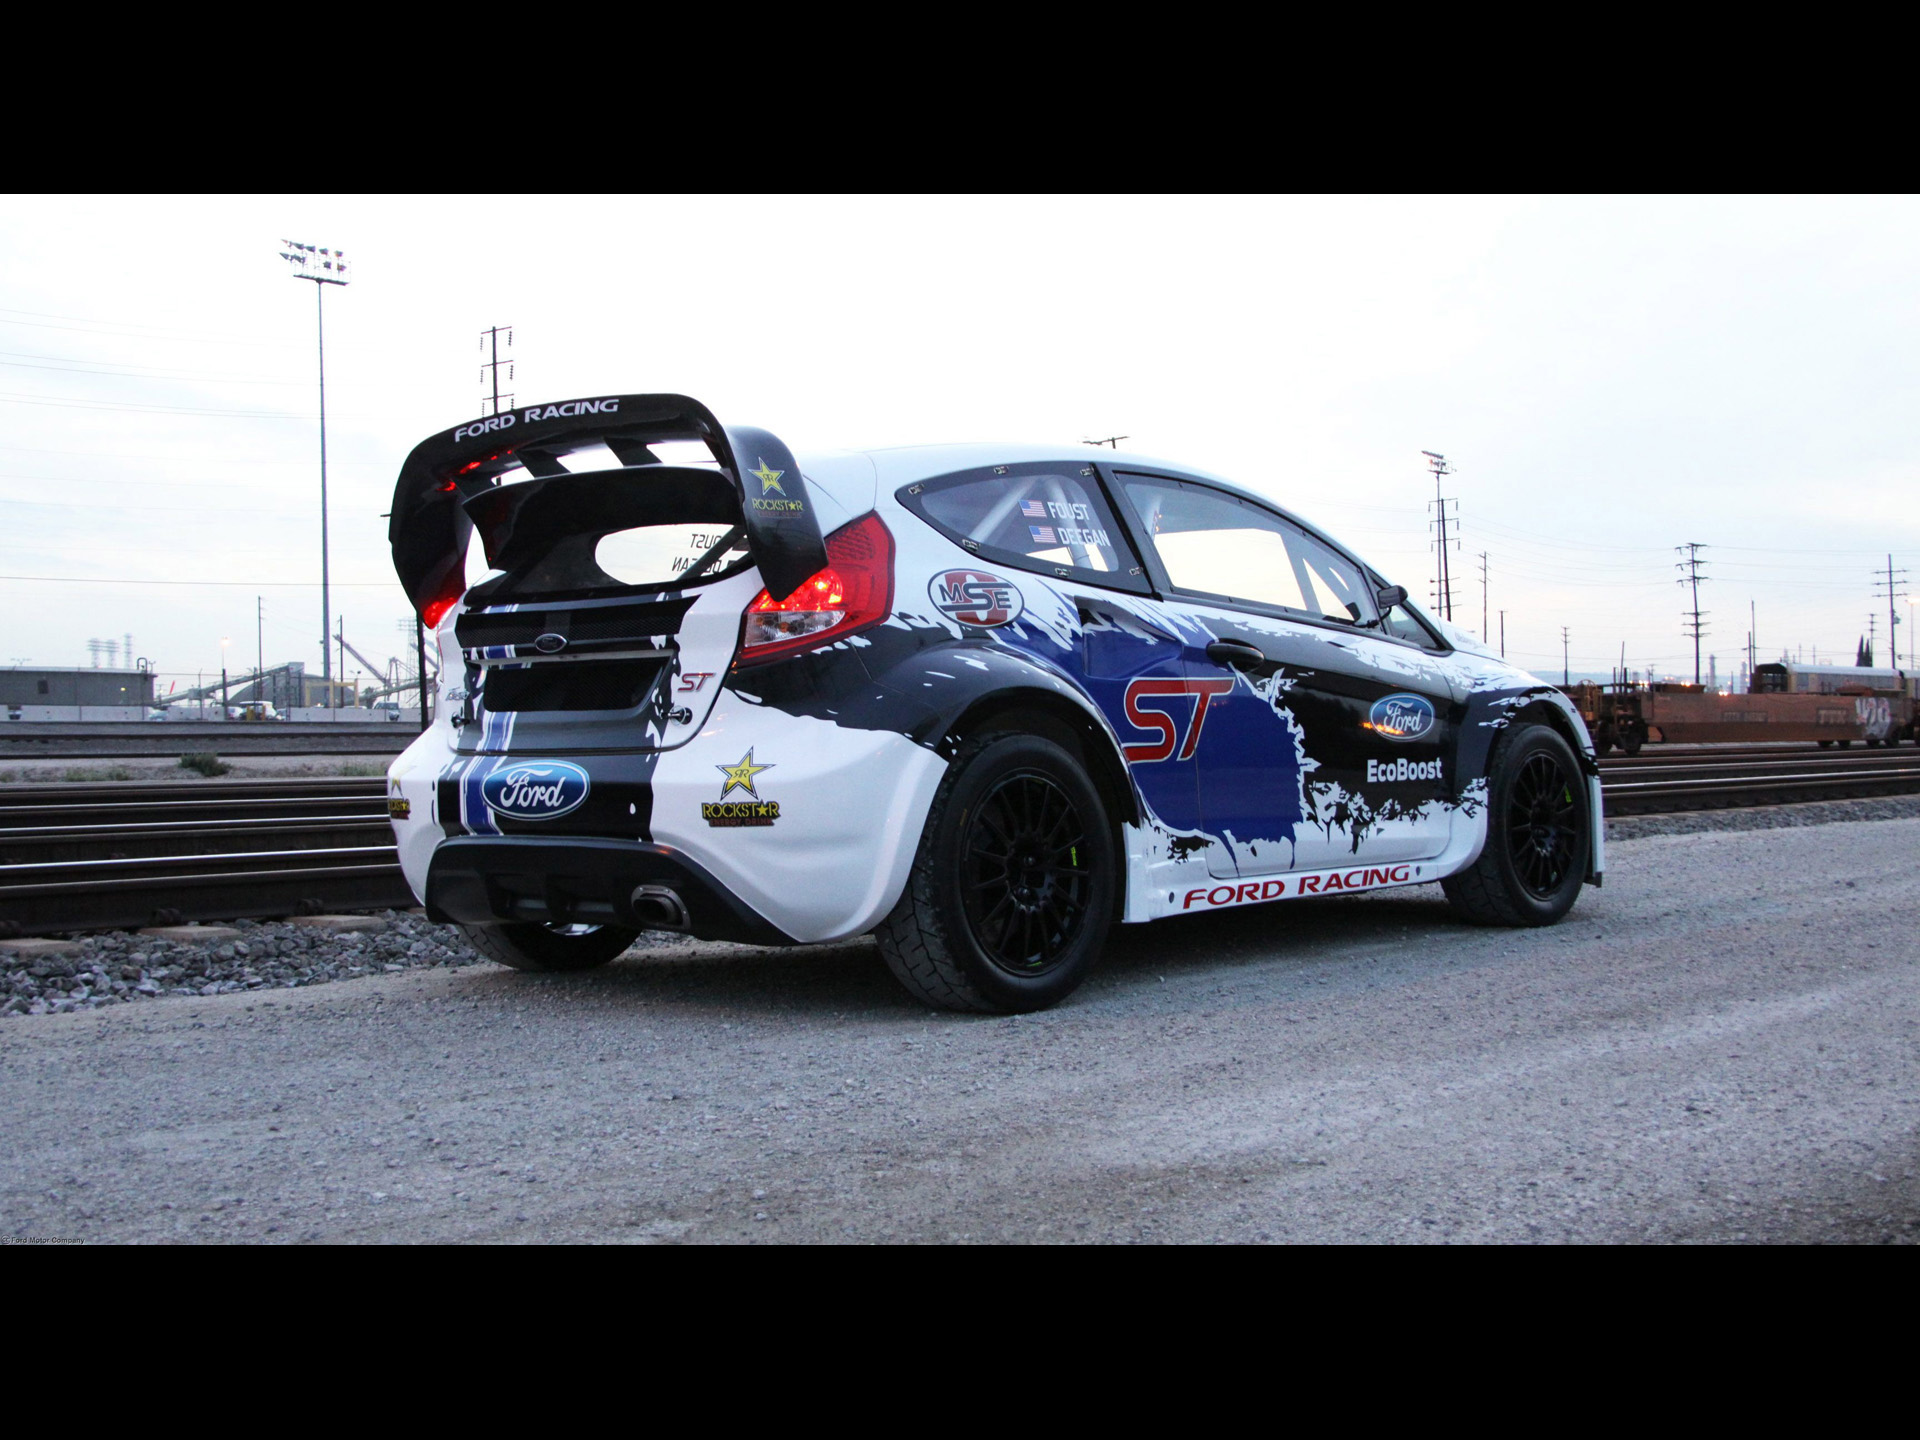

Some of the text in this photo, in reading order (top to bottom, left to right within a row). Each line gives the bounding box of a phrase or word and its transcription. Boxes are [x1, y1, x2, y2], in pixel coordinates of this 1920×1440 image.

[455, 399, 619, 442] FORD RACING
[1047, 501, 1088, 521] FOUST
[1057, 527, 1111, 547] DEEGAN
[938, 582, 1014, 612] MSE
[677, 672, 716, 692] ST
[1122, 677, 1236, 763] ST
[1382, 701, 1423, 733] Ford
[1367, 757, 1443, 783] EcoBoost
[500, 768, 566, 808] Ford
[1183, 865, 1410, 910] FORD RACING
